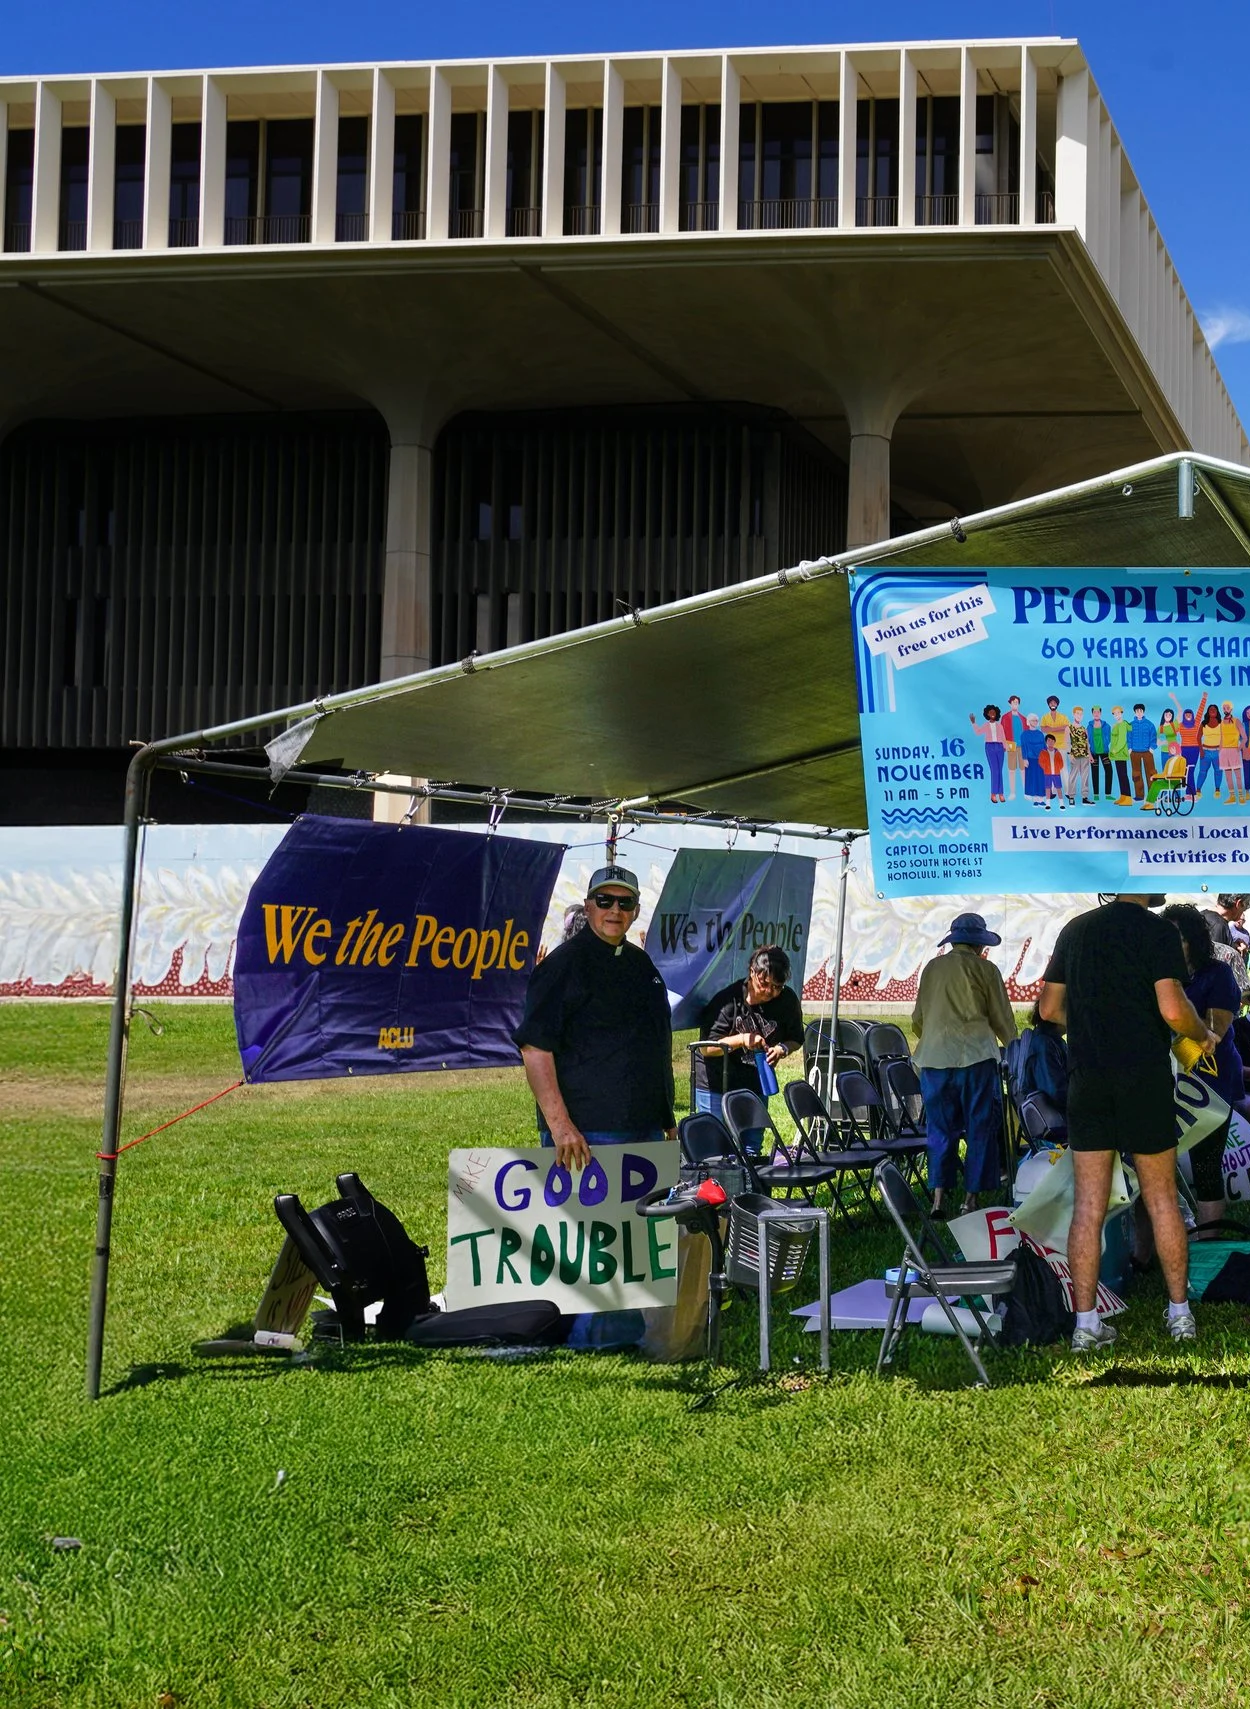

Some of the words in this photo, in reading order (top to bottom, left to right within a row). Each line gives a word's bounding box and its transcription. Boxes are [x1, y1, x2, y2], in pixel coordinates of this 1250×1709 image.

[1011, 585, 1246, 624] PEOPLE’S
[874, 624, 907, 643] Join
[909, 614, 927, 630] us
[928, 607, 951, 624] for
[954, 595, 984, 614] this
[897, 639, 928, 657] free
[930, 620, 975, 646] event!
[1041, 637, 1074, 659] 60
[1083, 637, 1148, 658] YEARS
[1156, 636, 1189, 658] OF
[1058, 666, 1112, 688] CIVIL
[1121, 665, 1222, 687] LIBERTIES
[1230, 665, 1250, 686] IN
[875, 745, 935, 760] SUNDAY,
[940, 738, 965, 757] 16
[877, 763, 985, 783] NOVEMBER
[884, 790, 894, 802] 11
[898, 789, 919, 801] AM
[936, 787, 944, 800] 5
[950, 787, 970, 799] PM
[1011, 825, 1051, 839] Live
[1054, 825, 1188, 840] Performances
[1199, 825, 1248, 839] Local
[885, 844, 934, 856] CAPITOL
[939, 842, 988, 854] MODERN
[1139, 850, 1227, 864] Activities
[887, 860, 906, 870] 250
[909, 858, 939, 868] SOUTH
[942, 857, 971, 867] HOTEL
[974, 857, 983, 866] ST
[943, 870, 952, 878] HI
[955, 869, 982, 878] 96813
[262, 903, 333, 966] We
[334, 908, 405, 967] the
[405, 914, 529, 980] People
[660, 913, 698, 954] We
[706, 911, 733, 953] th
[377, 1027, 414, 1049] ACLU
[453, 1151, 492, 1204] MAKE
[494, 1153, 658, 1211] GOOD
[450, 1216, 677, 1287] TROUBLE
